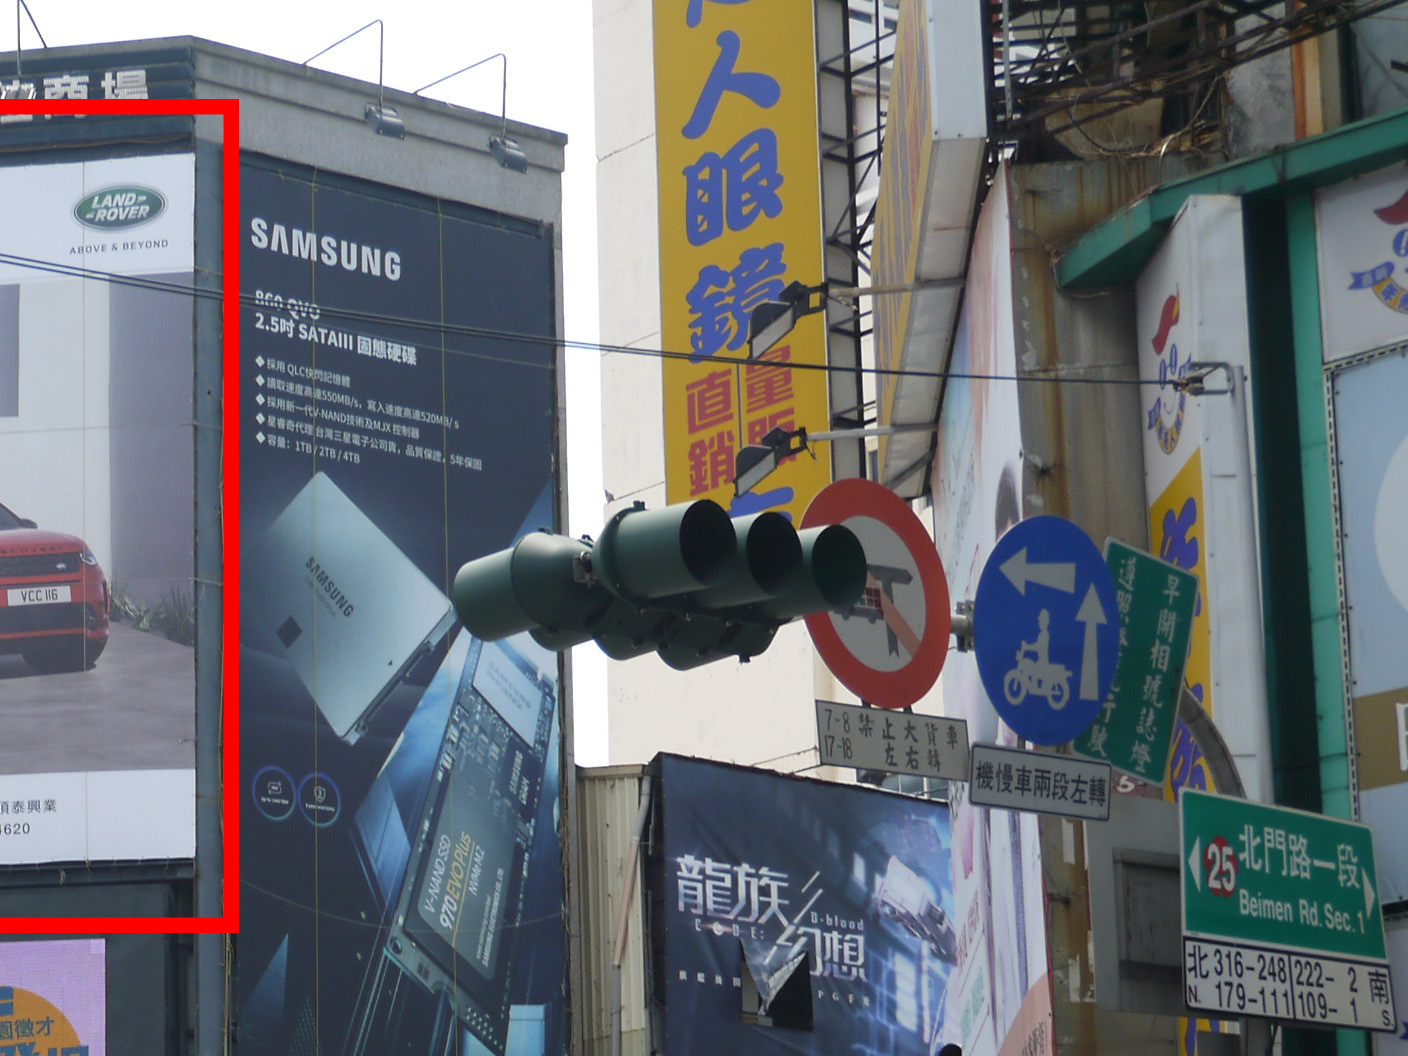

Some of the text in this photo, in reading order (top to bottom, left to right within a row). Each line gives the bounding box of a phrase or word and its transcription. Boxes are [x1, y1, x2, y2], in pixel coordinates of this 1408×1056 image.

[682, 0, 788, 364] 人眼鏡
[70, 239, 169, 255] ABOVE & BEYOND
[250, 217, 402, 281] SAMSUNG
[255, 312, 418, 366] 2.5吋 SATAIII 固態硬碟
[295, 440, 312, 453] 1TB
[319, 445, 336, 459] 2TB
[343, 449, 360, 464] 4TB
[686, 368, 736, 497] 直銷
[20, 590, 42, 602] VCC
[305, 556, 354, 617] SAMSUNG
[823, 708, 959, 750] 7-8 禁止大貨車
[823, 736, 942, 773] 17-18 左右轉
[975, 760, 1107, 808] 機慢車兩段左轉
[1206, 842, 1236, 893] 25
[1238, 823, 1360, 890] 北門路一段
[439, 894, 458, 931] 970
[677, 854, 792, 930] 龍族
[1239, 888, 1366, 935] Beimen Rd. Sec. 1
[1187, 945, 1288, 984] 北 316-248
[1368, 968, 1390, 1006] 南
[1215, 981, 1291, 1017] 179-111
